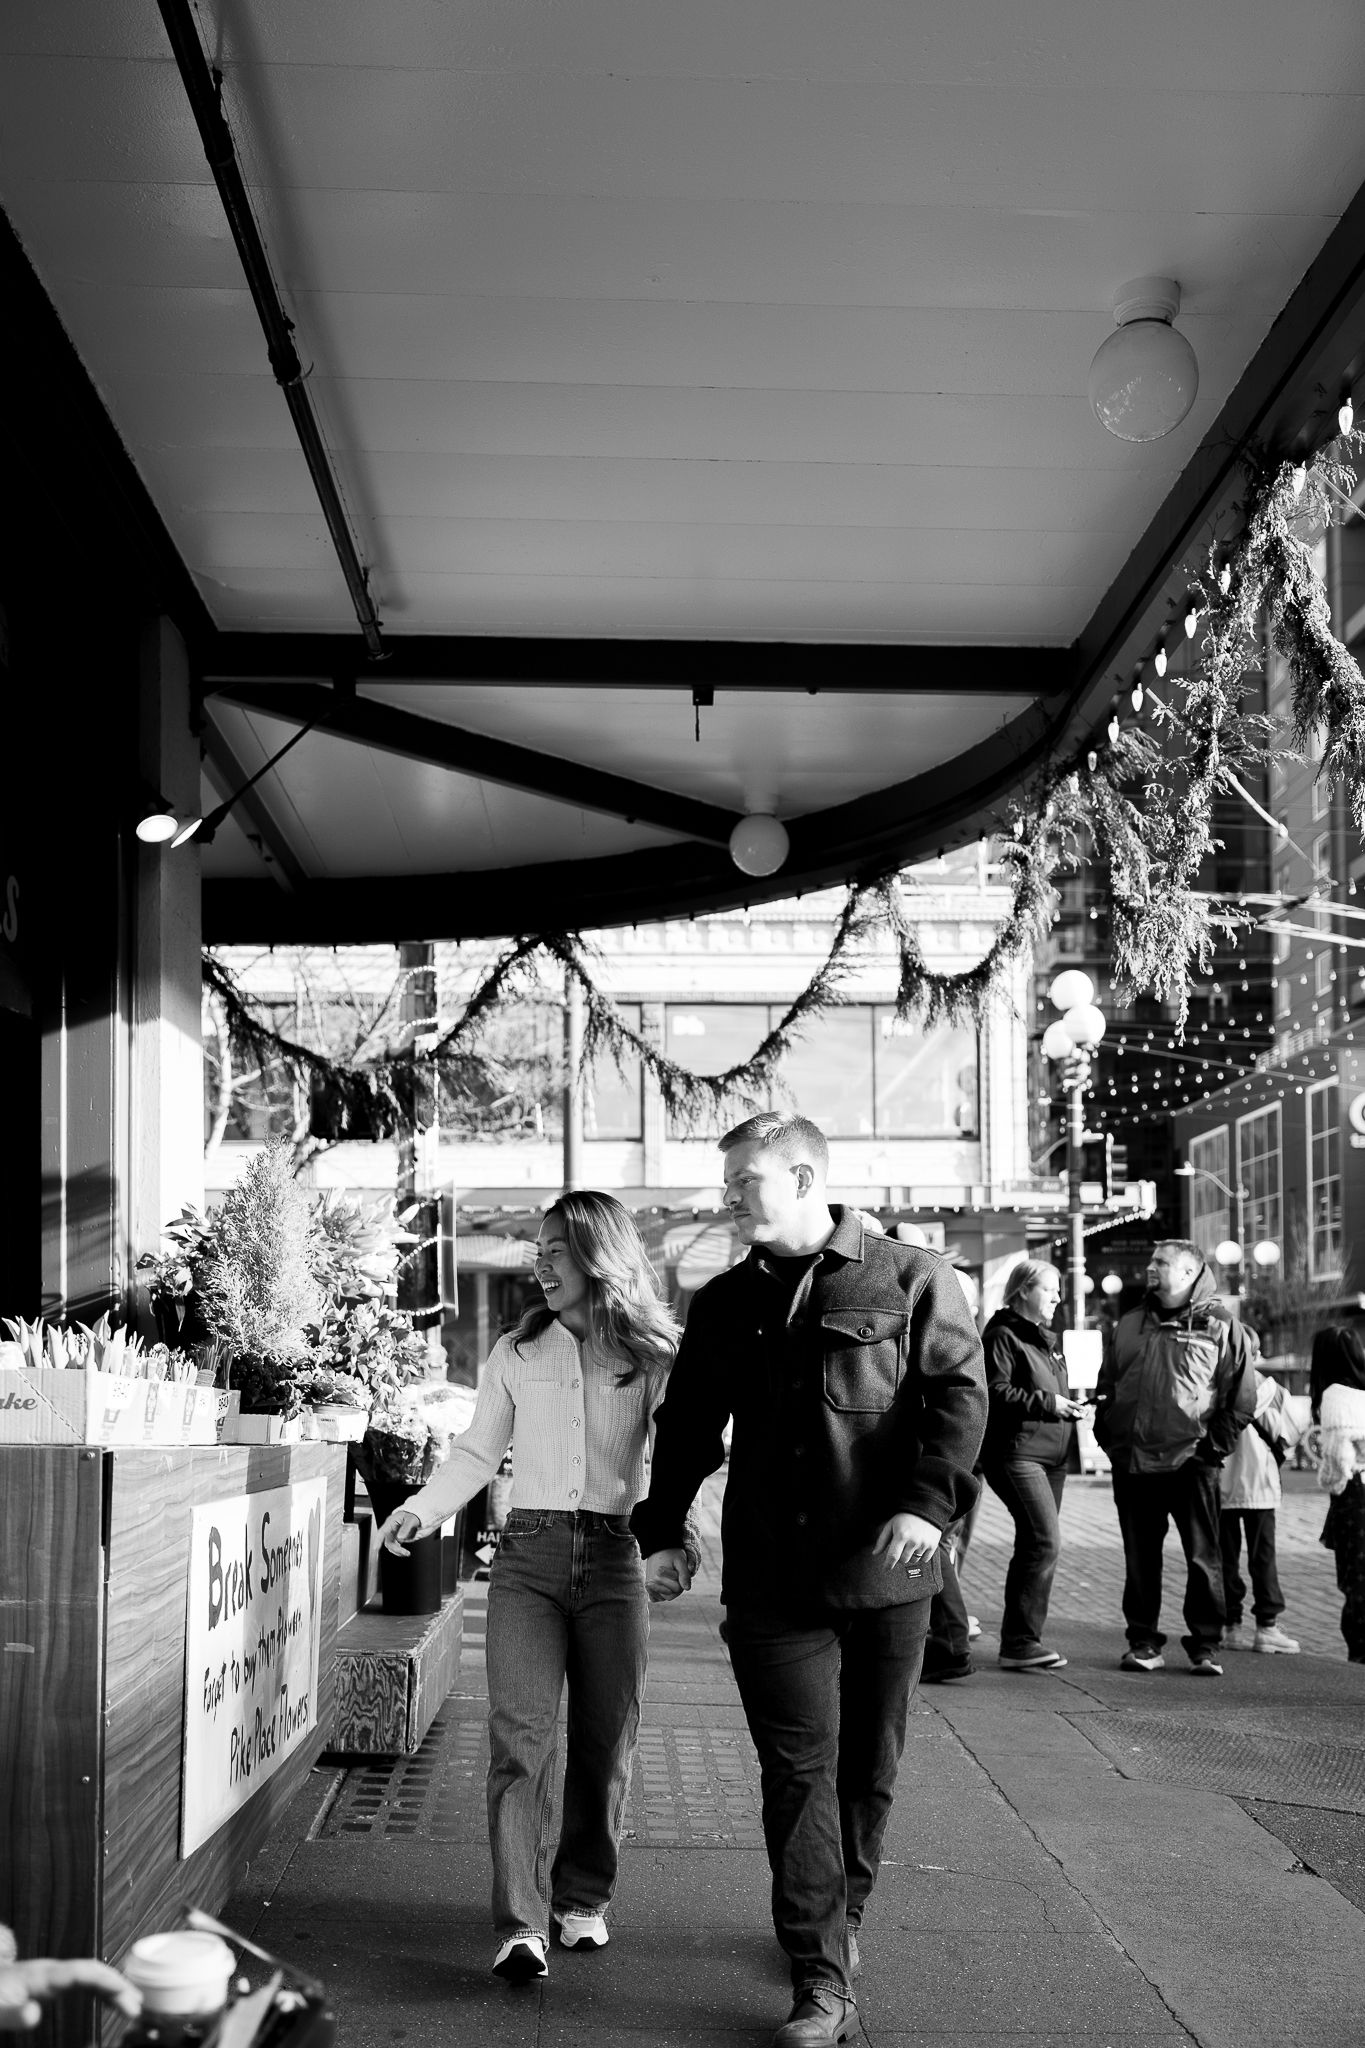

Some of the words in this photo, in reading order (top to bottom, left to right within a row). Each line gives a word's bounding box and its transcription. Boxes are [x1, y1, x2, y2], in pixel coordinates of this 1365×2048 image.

[208, 1522, 253, 1632] Break
[203, 1660, 227, 1723] Forget
[243, 1650, 258, 1696] buy
[258, 1624, 275, 1669] them
[229, 1724, 251, 1787] Pike
[254, 1706, 276, 1769] Place
[278, 1683, 308, 1747] Flowers
